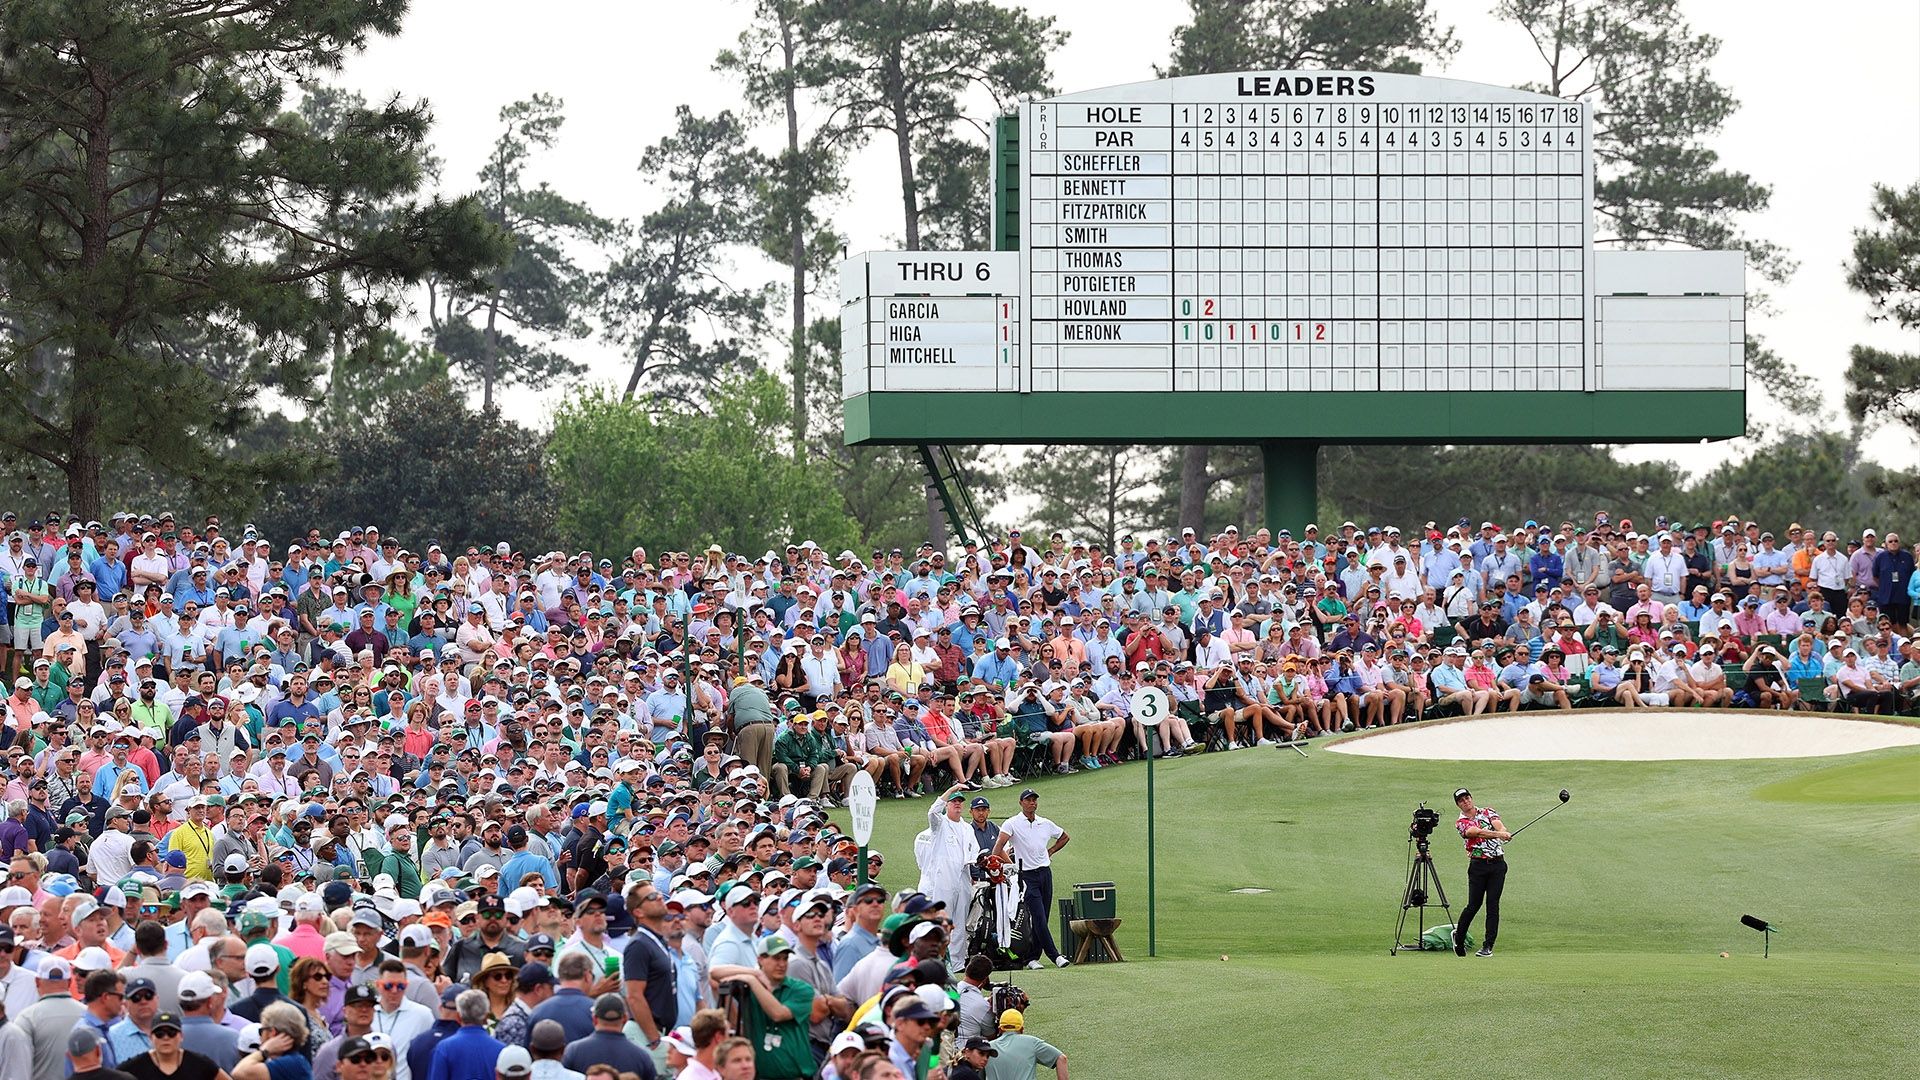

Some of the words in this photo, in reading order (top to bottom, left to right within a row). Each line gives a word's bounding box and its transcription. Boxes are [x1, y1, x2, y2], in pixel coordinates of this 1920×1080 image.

[1237, 76, 1375, 96] LEADERS
[1087, 107, 1142, 123] HOLE
[1182, 107, 1189, 124] 1
[1204, 107, 1213, 124] 2
[1226, 107, 1236, 124] 3
[1248, 107, 1258, 124] 4
[1270, 107, 1280, 124] 5
[1293, 107, 1303, 124] 6
[1315, 107, 1325, 124] 7
[1337, 107, 1347, 124] 8
[1360, 107, 1371, 124] 9
[1382, 107, 1399, 124] 10
[1407, 107, 1420, 124] 11
[1428, 107, 1444, 124] 12
[1450, 107, 1467, 124] 13
[1472, 107, 1489, 124] 14
[1495, 107, 1512, 124] 15
[1517, 107, 1534, 124] 16
[1540, 107, 1555, 124] 17
[1562, 107, 1579, 124] 18
[1039, 105, 1048, 150] PRIOR
[1095, 132, 1134, 146] PAR
[1180, 131, 1191, 148] 4
[1203, 131, 1214, 148] 5
[1225, 131, 1236, 148] 4
[1248, 130, 1258, 148] 3
[1270, 131, 1280, 147] 4
[1293, 130, 1303, 148] 3
[1314, 131, 1325, 147] 4
[1337, 131, 1347, 148] 5
[1360, 131, 1370, 148] 4
[1385, 131, 1396, 148] 4
[1408, 131, 1418, 147] 4
[1431, 130, 1441, 148] 3
[1453, 131, 1463, 148] 5
[1475, 131, 1485, 147] 4
[1498, 131, 1508, 148] 5
[1520, 130, 1530, 148] 3
[1542, 131, 1552, 147] 4
[1565, 131, 1575, 147] 4
[1064, 155, 1140, 171] SCHEFFLER
[1063, 180, 1126, 195] BENNETT
[1062, 204, 1147, 219] FITZPATRICK
[1064, 228, 1107, 243] SMITH
[1065, 252, 1123, 268] THOMAS
[897, 263, 963, 281] THRU
[975, 262, 991, 282] 6
[1064, 276, 1136, 292] POTGIETER
[889, 303, 939, 318] GARCIA
[1002, 303, 1008, 318] 1
[1064, 300, 1127, 315] HOVLAND
[1182, 300, 1191, 316] 0
[1205, 300, 1214, 316] 2
[890, 326, 922, 341] HIGA
[1002, 326, 1008, 341] 1
[1064, 325, 1122, 340] MERONK
[1182, 325, 1190, 340] 1
[1205, 325, 1214, 340] 0
[1228, 325, 1235, 340] 1
[1250, 325, 1257, 340] 1
[1271, 325, 1280, 340] 0
[1295, 325, 1301, 340] 1
[1316, 325, 1325, 340] 2
[890, 348, 957, 363] MITCHELL
[1002, 348, 1008, 363] 1
[1142, 694, 1158, 718] 3
